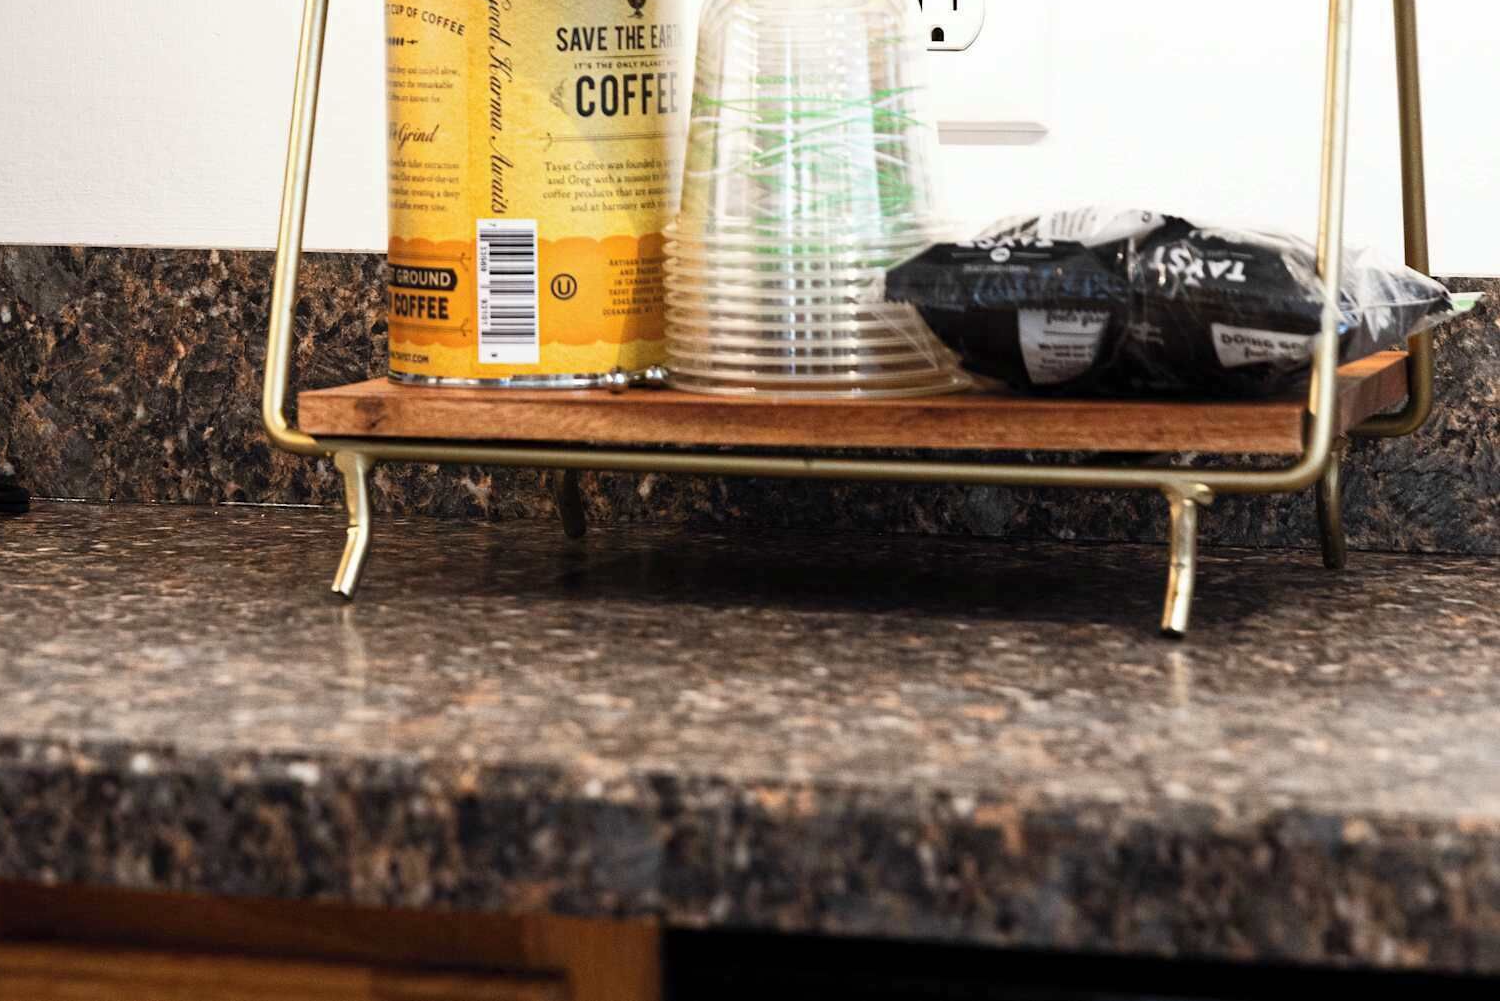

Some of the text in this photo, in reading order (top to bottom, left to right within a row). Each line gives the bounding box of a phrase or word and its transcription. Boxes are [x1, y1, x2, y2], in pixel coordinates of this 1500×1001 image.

[406, 6, 418, 18] OF
[421, 10, 466, 36] COFFEE
[556, 26, 608, 52] SAVE
[614, 25, 645, 50] THE
[616, 60, 638, 68] ONLY
[488, 46, 512, 132] Karma
[576, 72, 679, 118] COFFEE
[395, 268, 451, 287] GROUND
[395, 293, 449, 320] COFFEE
